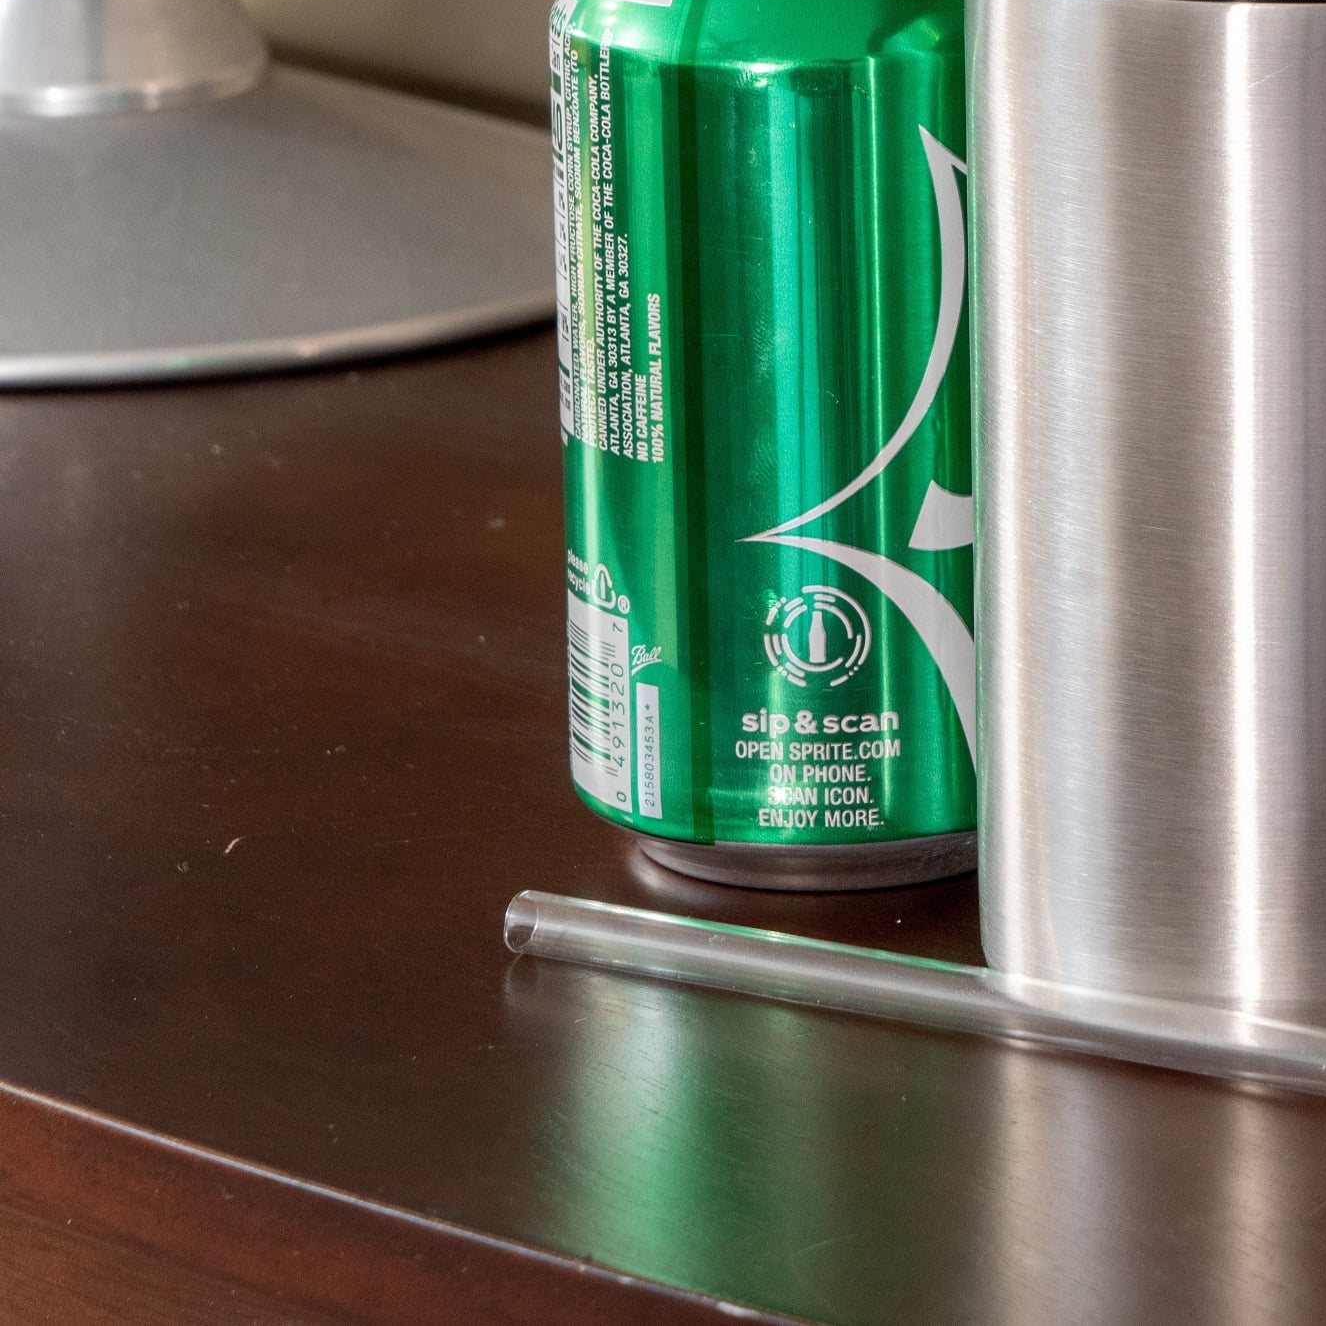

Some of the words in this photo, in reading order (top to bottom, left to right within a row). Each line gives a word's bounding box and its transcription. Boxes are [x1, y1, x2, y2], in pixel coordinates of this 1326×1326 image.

[571, 50, 579, 73] (TO
[571, 75, 580, 143] BENZOATE
[588, 73, 599, 142] COMPANY,
[601, 103, 612, 179] COCA-COLA
[573, 145, 582, 199] SODIUM
[591, 145, 601, 221] COCA-COLA
[603, 181, 613, 207] THE
[568, 193, 577, 270] FRUCTOSE
[575, 202, 584, 260] CITRATE,
[593, 223, 602, 249] THE
[604, 210, 613, 229] OF
[594, 251, 603, 270] OF
[604, 232, 615, 291] MEMBER
[618, 233, 629, 277] 30327.
[577, 262, 585, 316] SODIUM
[594, 275, 605, 347] AUTHORITY
[606, 294, 615, 305] A
[619, 280, 629, 299] GA
[571, 302, 579, 350] WATER,
[606, 307, 616, 324] BY
[619, 301, 631, 365] ATLANTA,
[647, 293, 662, 356] FLAVORS
[578, 318, 588, 381] FLAVORS,
[597, 348, 606, 394] UNDER
[607, 327, 618, 368] 30313
[573, 353, 582, 440] CARBONATED
[608, 370, 618, 389] GA
[649, 358, 663, 421] NATURAL
[581, 382, 589, 444] NATURAL
[588, 386, 597, 448] PROTECT
[598, 396, 608, 451] CANNED
[609, 392, 620, 456] ATLANTA,
[621, 367, 634, 459] ASSOCIATION,
[635, 373, 647, 439] CAFFEINE
[637, 441, 649, 462] NO
[652, 423, 664, 463] 100%
[568, 548, 588, 575] please
[631, 644, 662, 671] Ball
[742, 707, 790, 739] sip
[795, 710, 819, 734] &
[823, 710, 900, 734] scan
[735, 740, 784, 760] OPEN
[789, 738, 901, 761] SPRITE.COM
[769, 764, 796, 783] ON
[803, 763, 871, 783] PHONE.
[758, 809, 818, 828] ENJOY
[824, 808, 884, 827] MORE.
[767, 786, 818, 806] SCAN
[824, 786, 874, 805] ICON.
